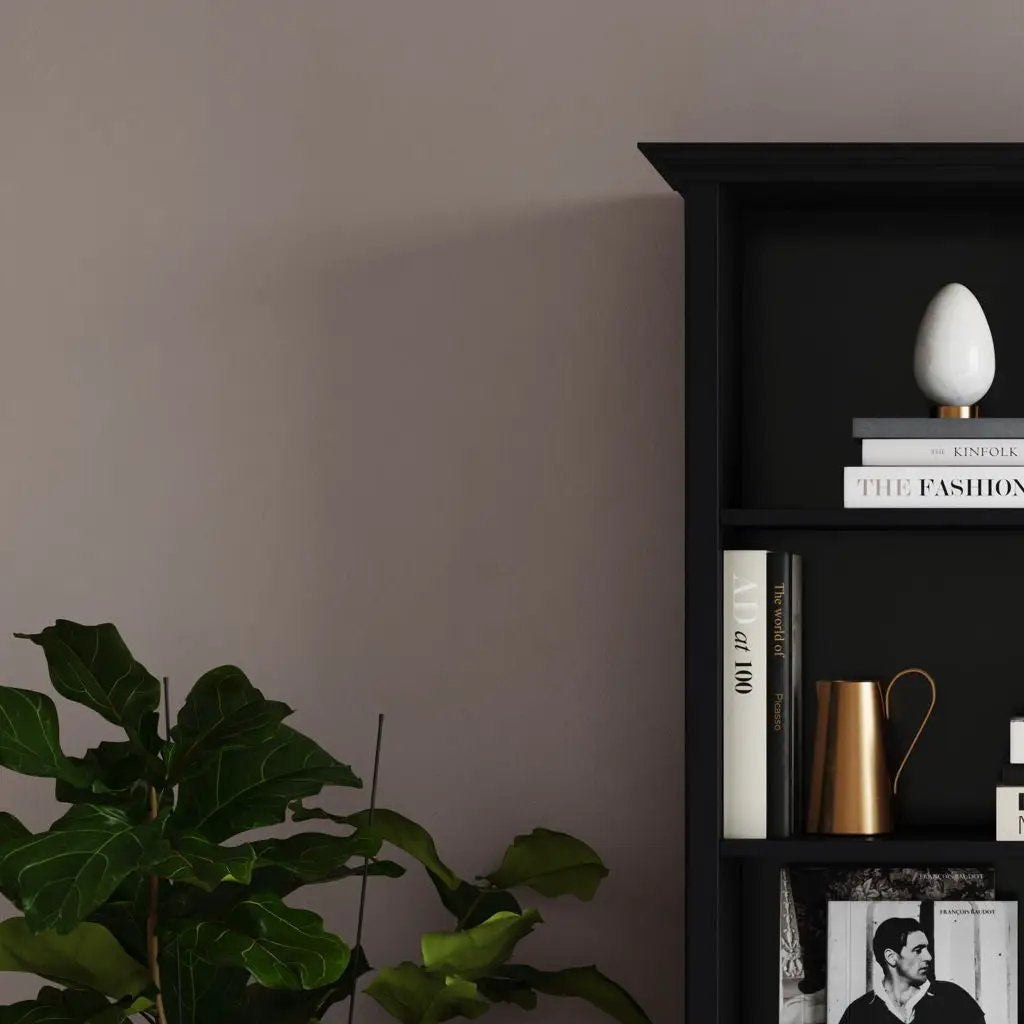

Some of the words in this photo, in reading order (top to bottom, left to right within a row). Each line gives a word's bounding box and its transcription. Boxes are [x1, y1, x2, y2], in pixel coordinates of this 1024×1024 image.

[954, 446, 1018, 457] KINFOLK
[857, 478, 911, 496] THE
[733, 573, 758, 624] AD
[774, 582, 785, 605] The
[774, 608, 785, 641] world
[734, 631, 751, 652] at
[774, 644, 785, 658] of
[734, 661, 753, 695] 100
[774, 693, 783, 731] Picasso
